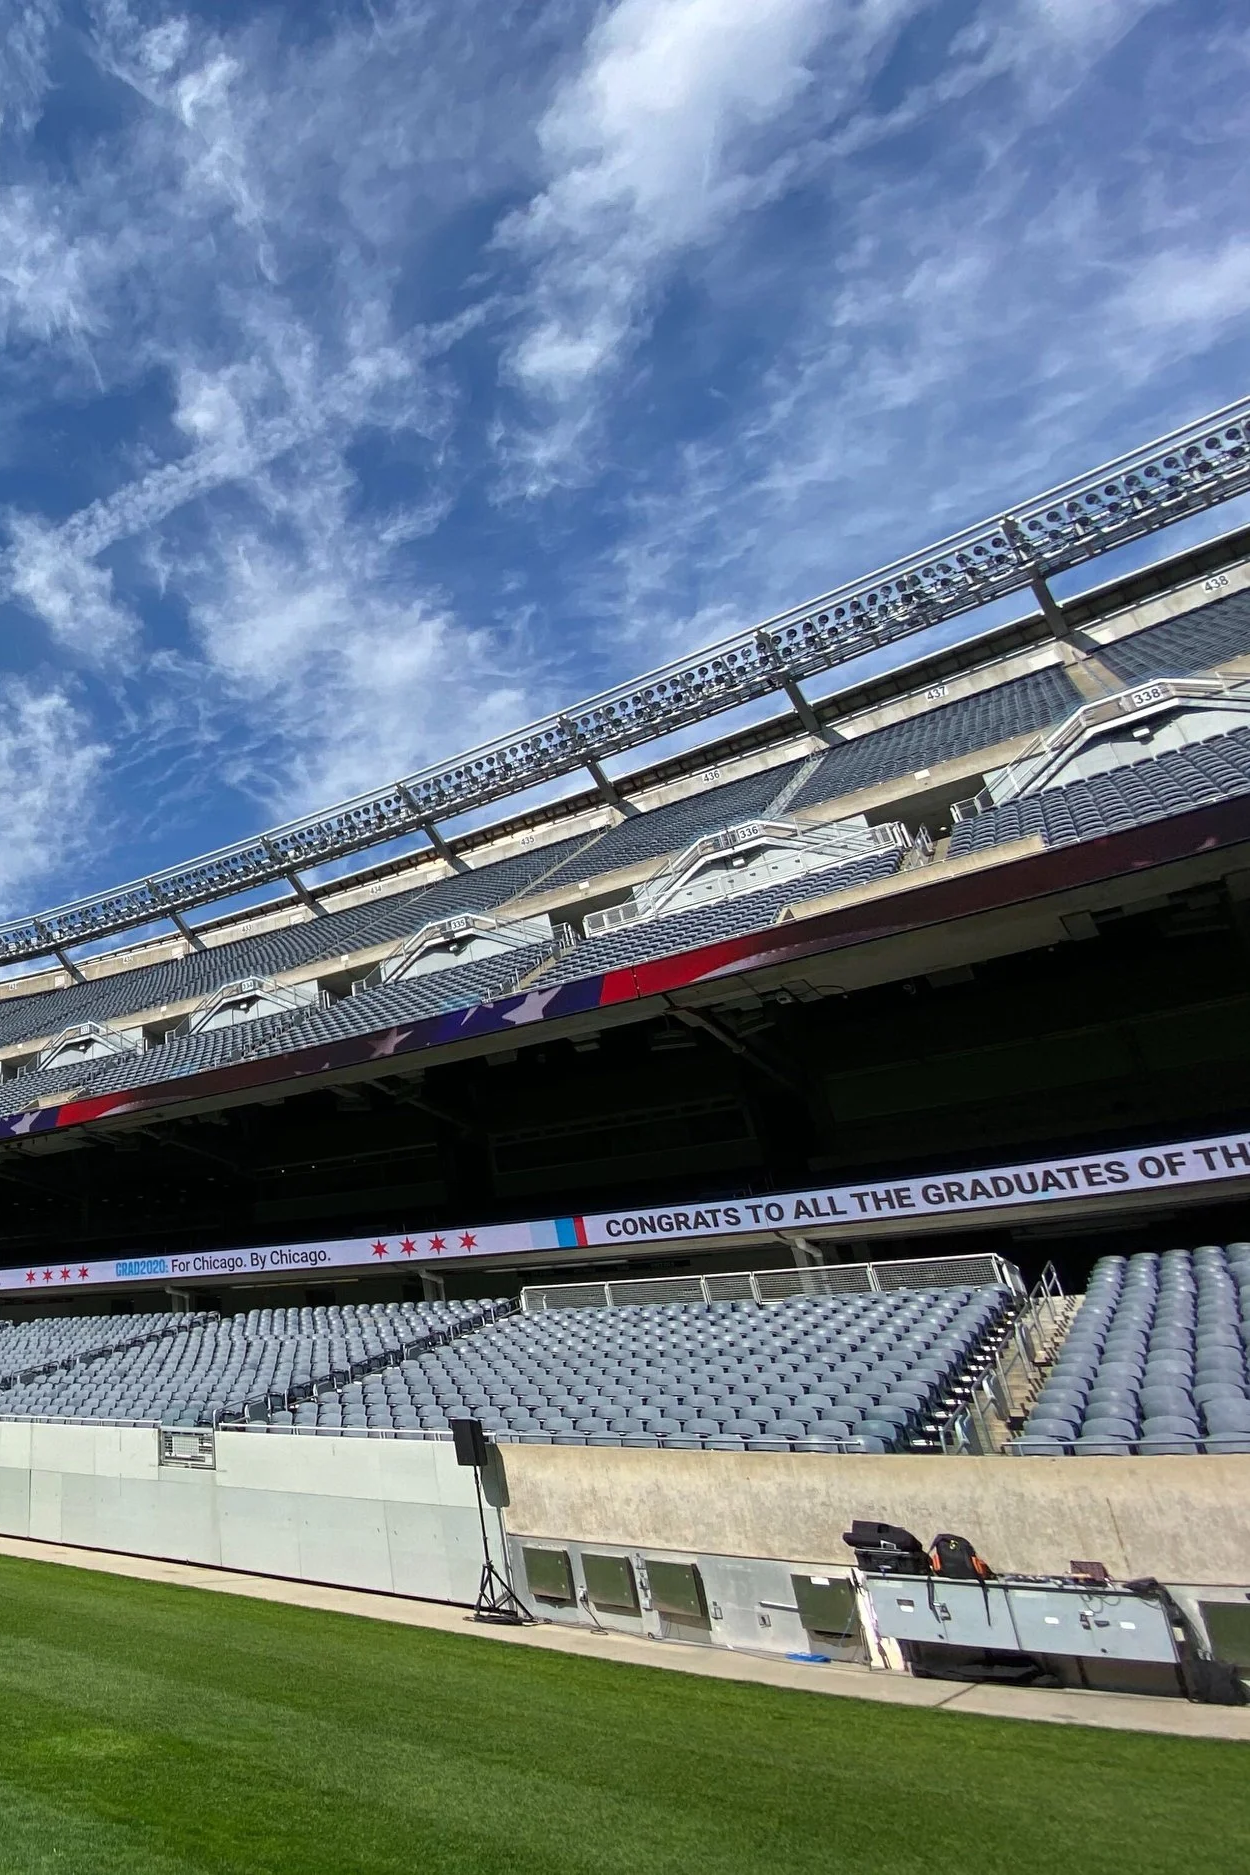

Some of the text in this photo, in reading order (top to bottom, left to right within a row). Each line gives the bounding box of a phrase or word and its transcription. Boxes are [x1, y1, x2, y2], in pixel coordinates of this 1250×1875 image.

[1205, 575, 1228, 590] 438
[927, 685, 945, 699] 437
[1133, 688, 1161, 705] 338
[703, 769, 720, 781] 436
[740, 825, 758, 838] 336
[520, 835, 535, 845] 435
[452, 919, 465, 930] 335
[605, 1139, 1250, 1238] CONGRATS TO ALL THE GRADUATES OF TH
[115, 1248, 331, 1277] GRAD2020: For Chicago. By Chicago.
